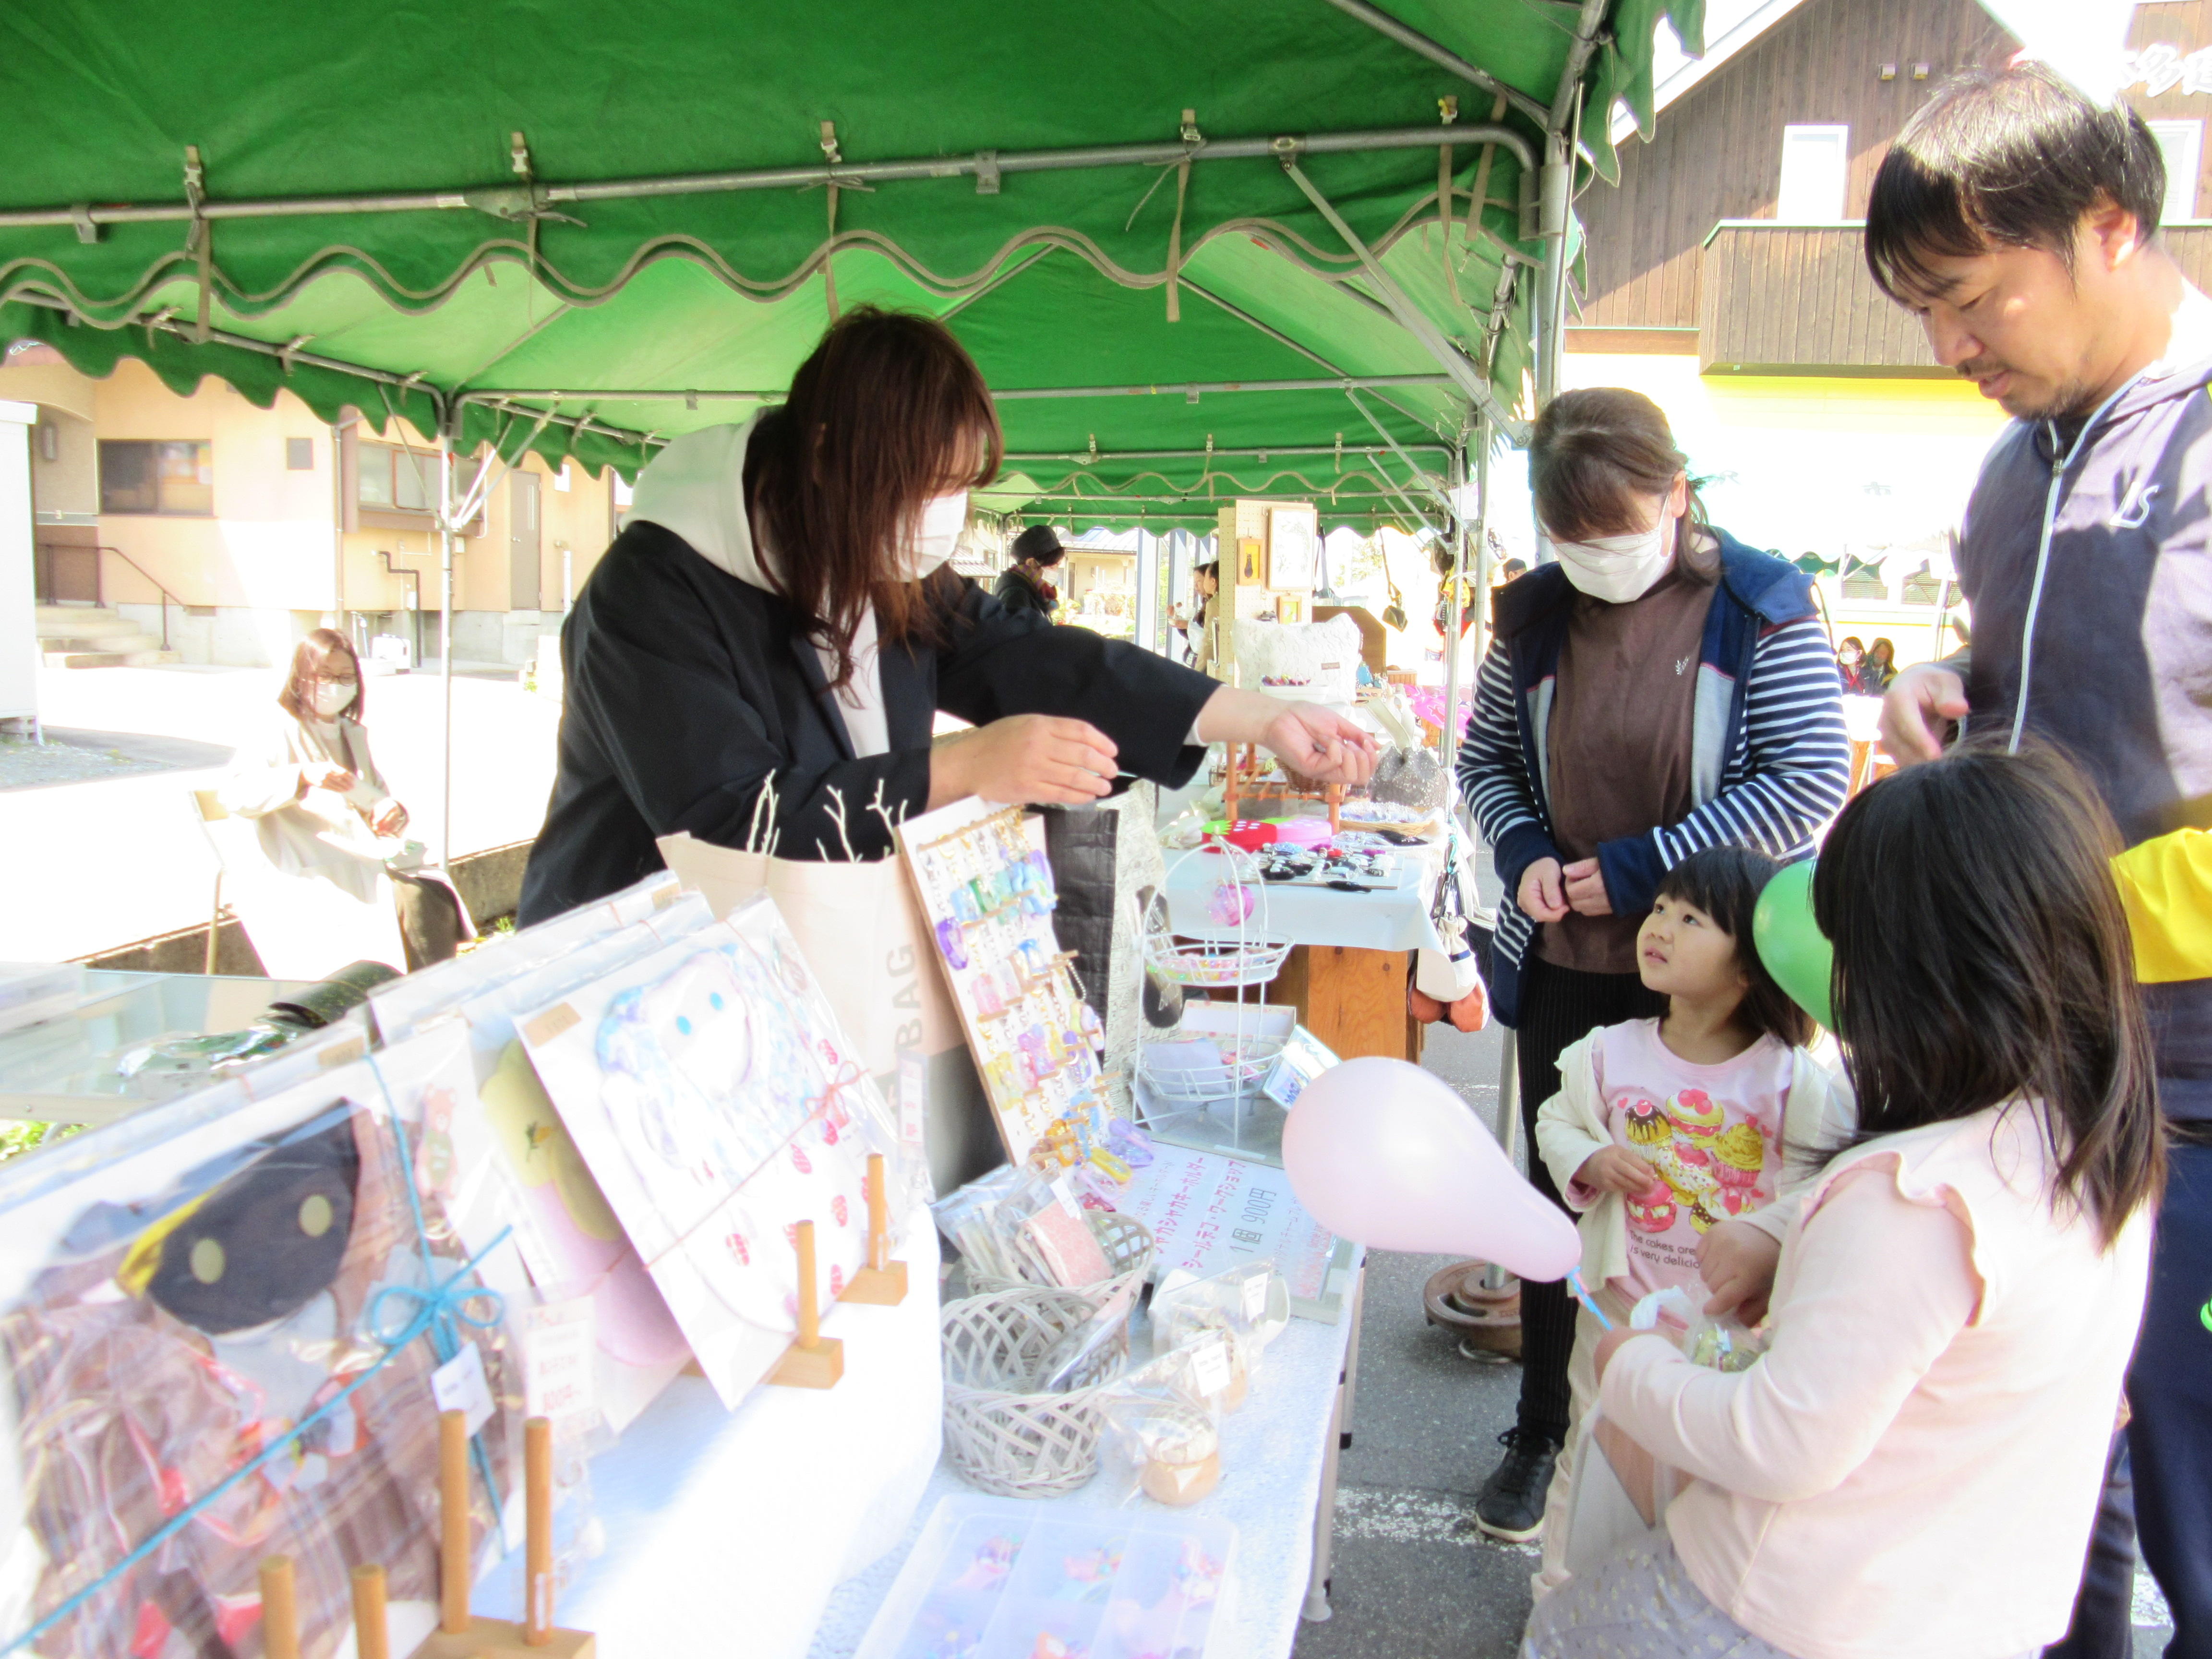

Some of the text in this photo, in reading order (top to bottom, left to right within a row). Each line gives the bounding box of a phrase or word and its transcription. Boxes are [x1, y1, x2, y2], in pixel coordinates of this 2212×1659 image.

[886, 944, 922, 1053] BAG
[1646, 1239, 1674, 1252] cakes
[1677, 1246, 1695, 1255] are
[1641, 1250, 1660, 1264] very
